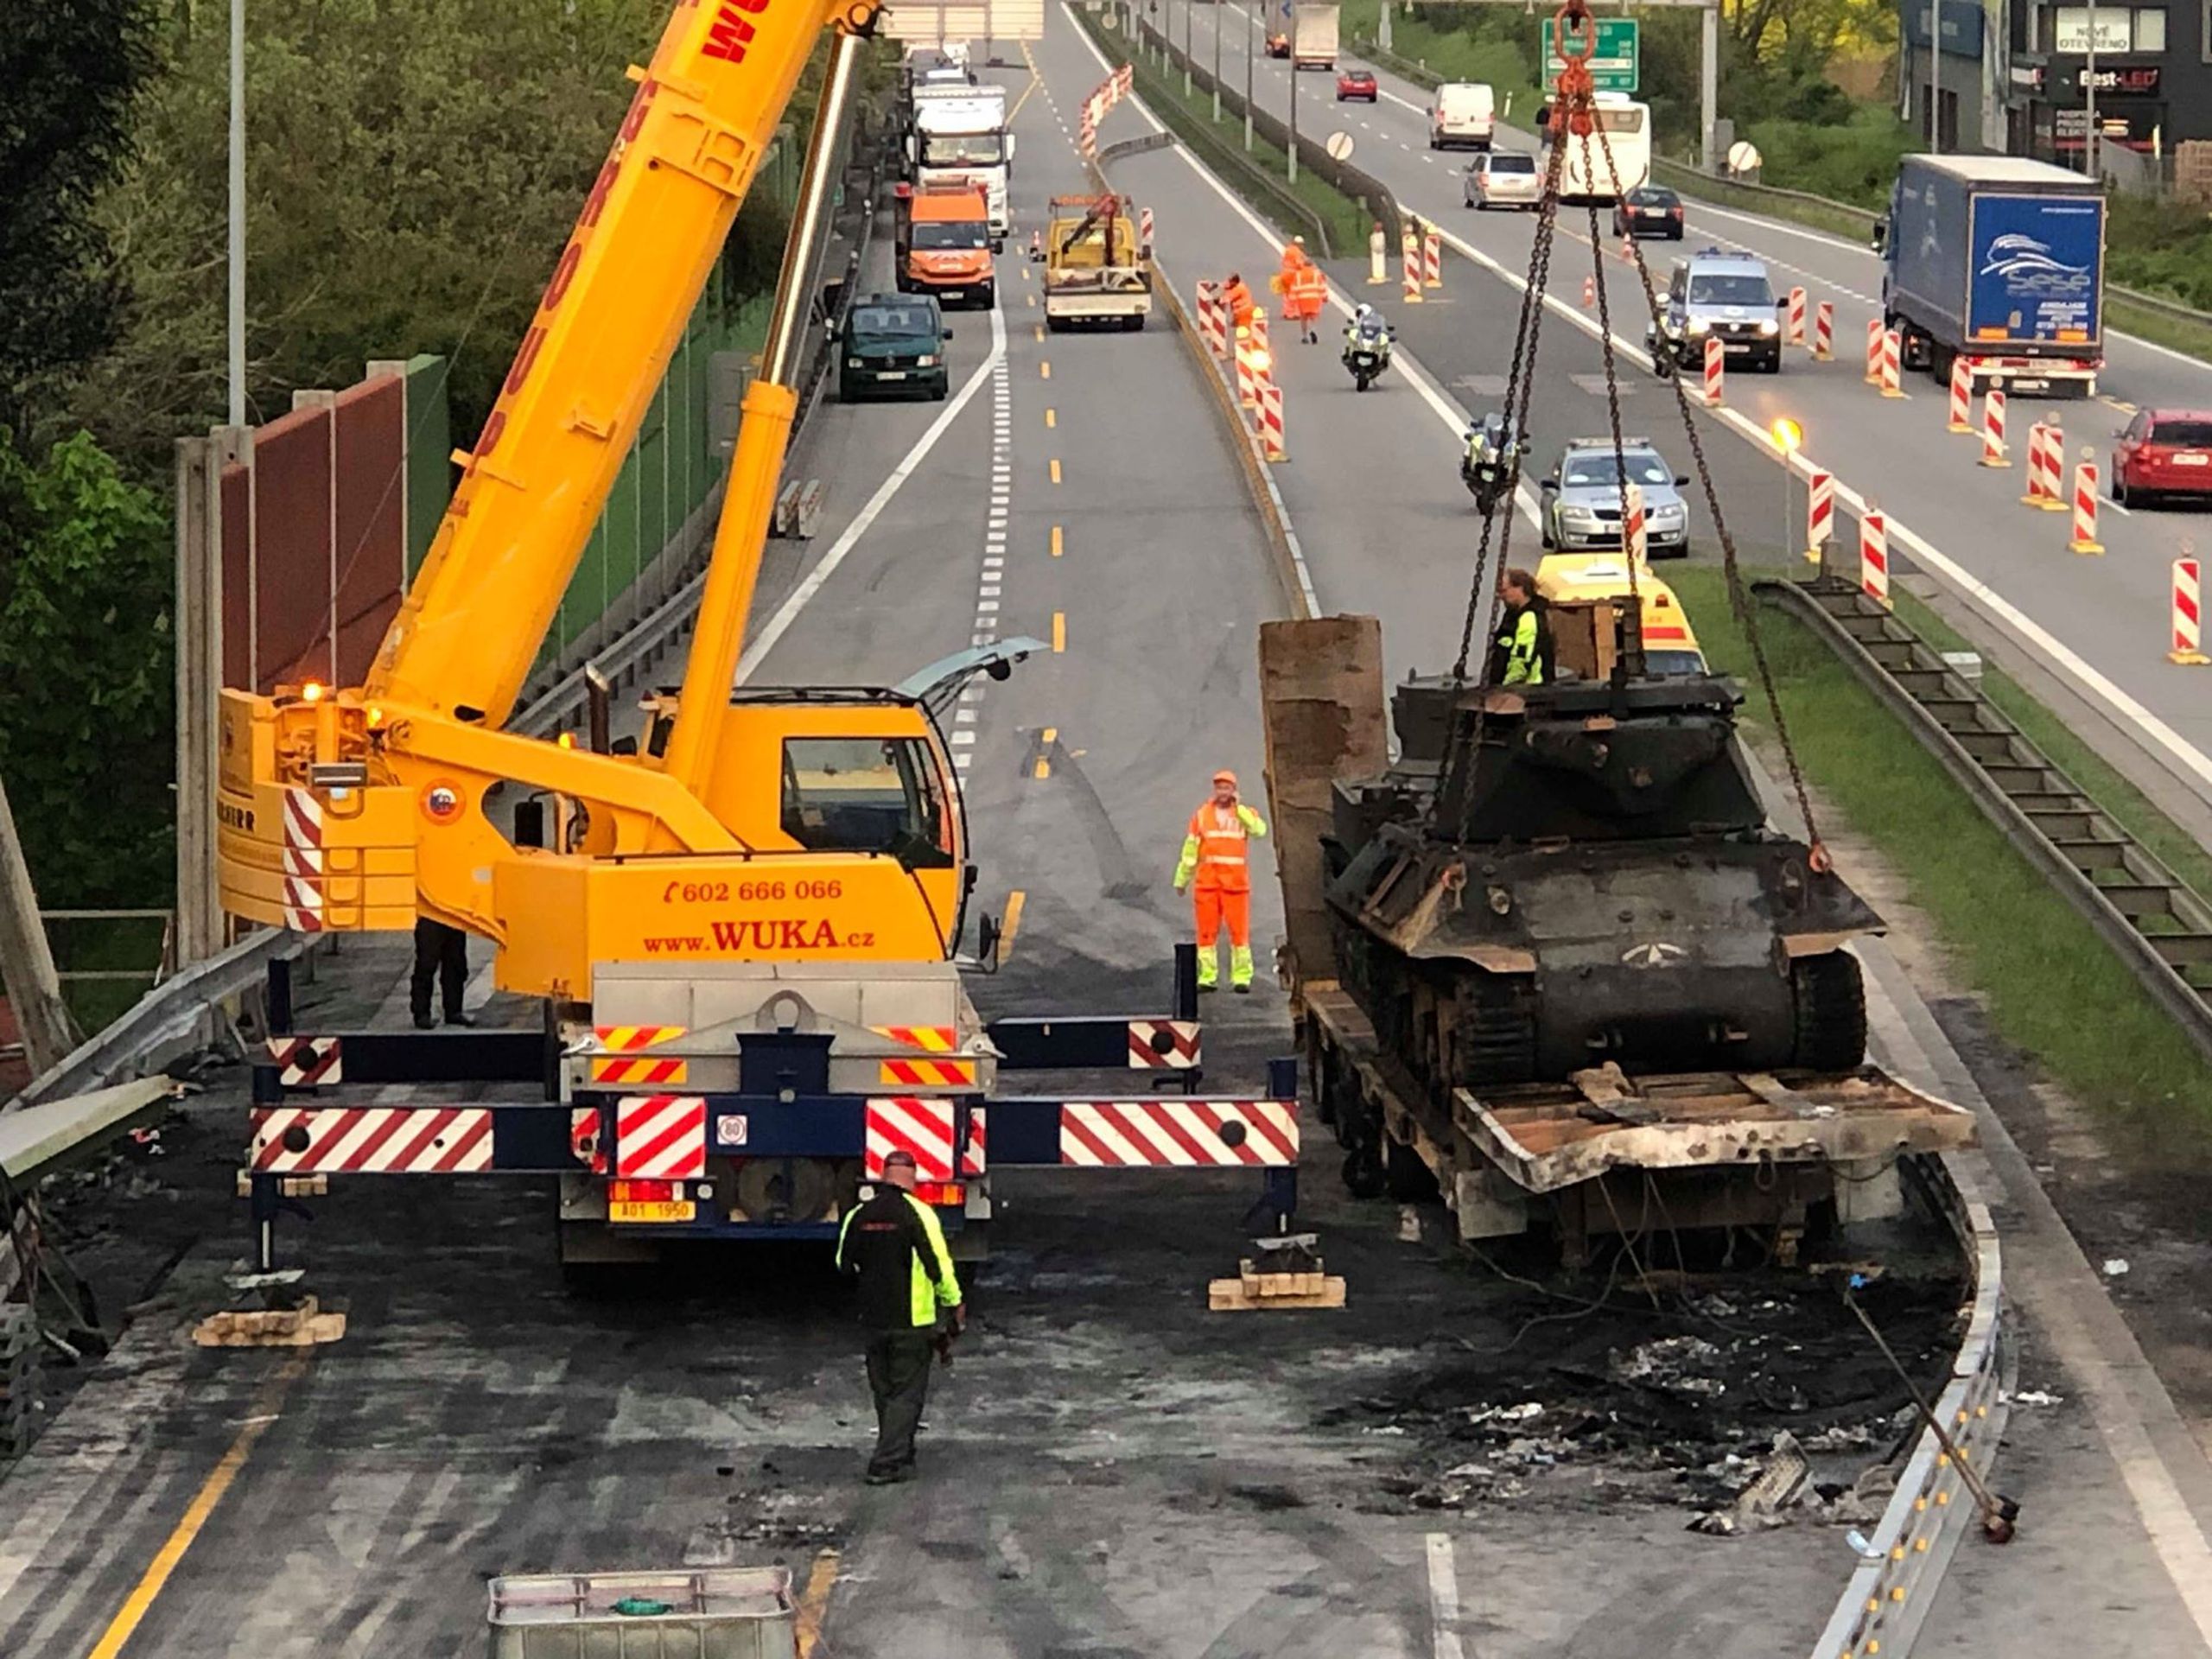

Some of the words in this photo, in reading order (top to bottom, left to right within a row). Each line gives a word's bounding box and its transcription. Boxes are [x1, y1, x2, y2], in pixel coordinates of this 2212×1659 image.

[683, 883, 729, 902] 602
[739, 881, 786, 901] 666
[795, 880, 842, 900] 066
[644, 918, 874, 953] www.WUKA.cz
[725, 1122, 740, 1136] 80
[657, 1202, 690, 1217] 1950
